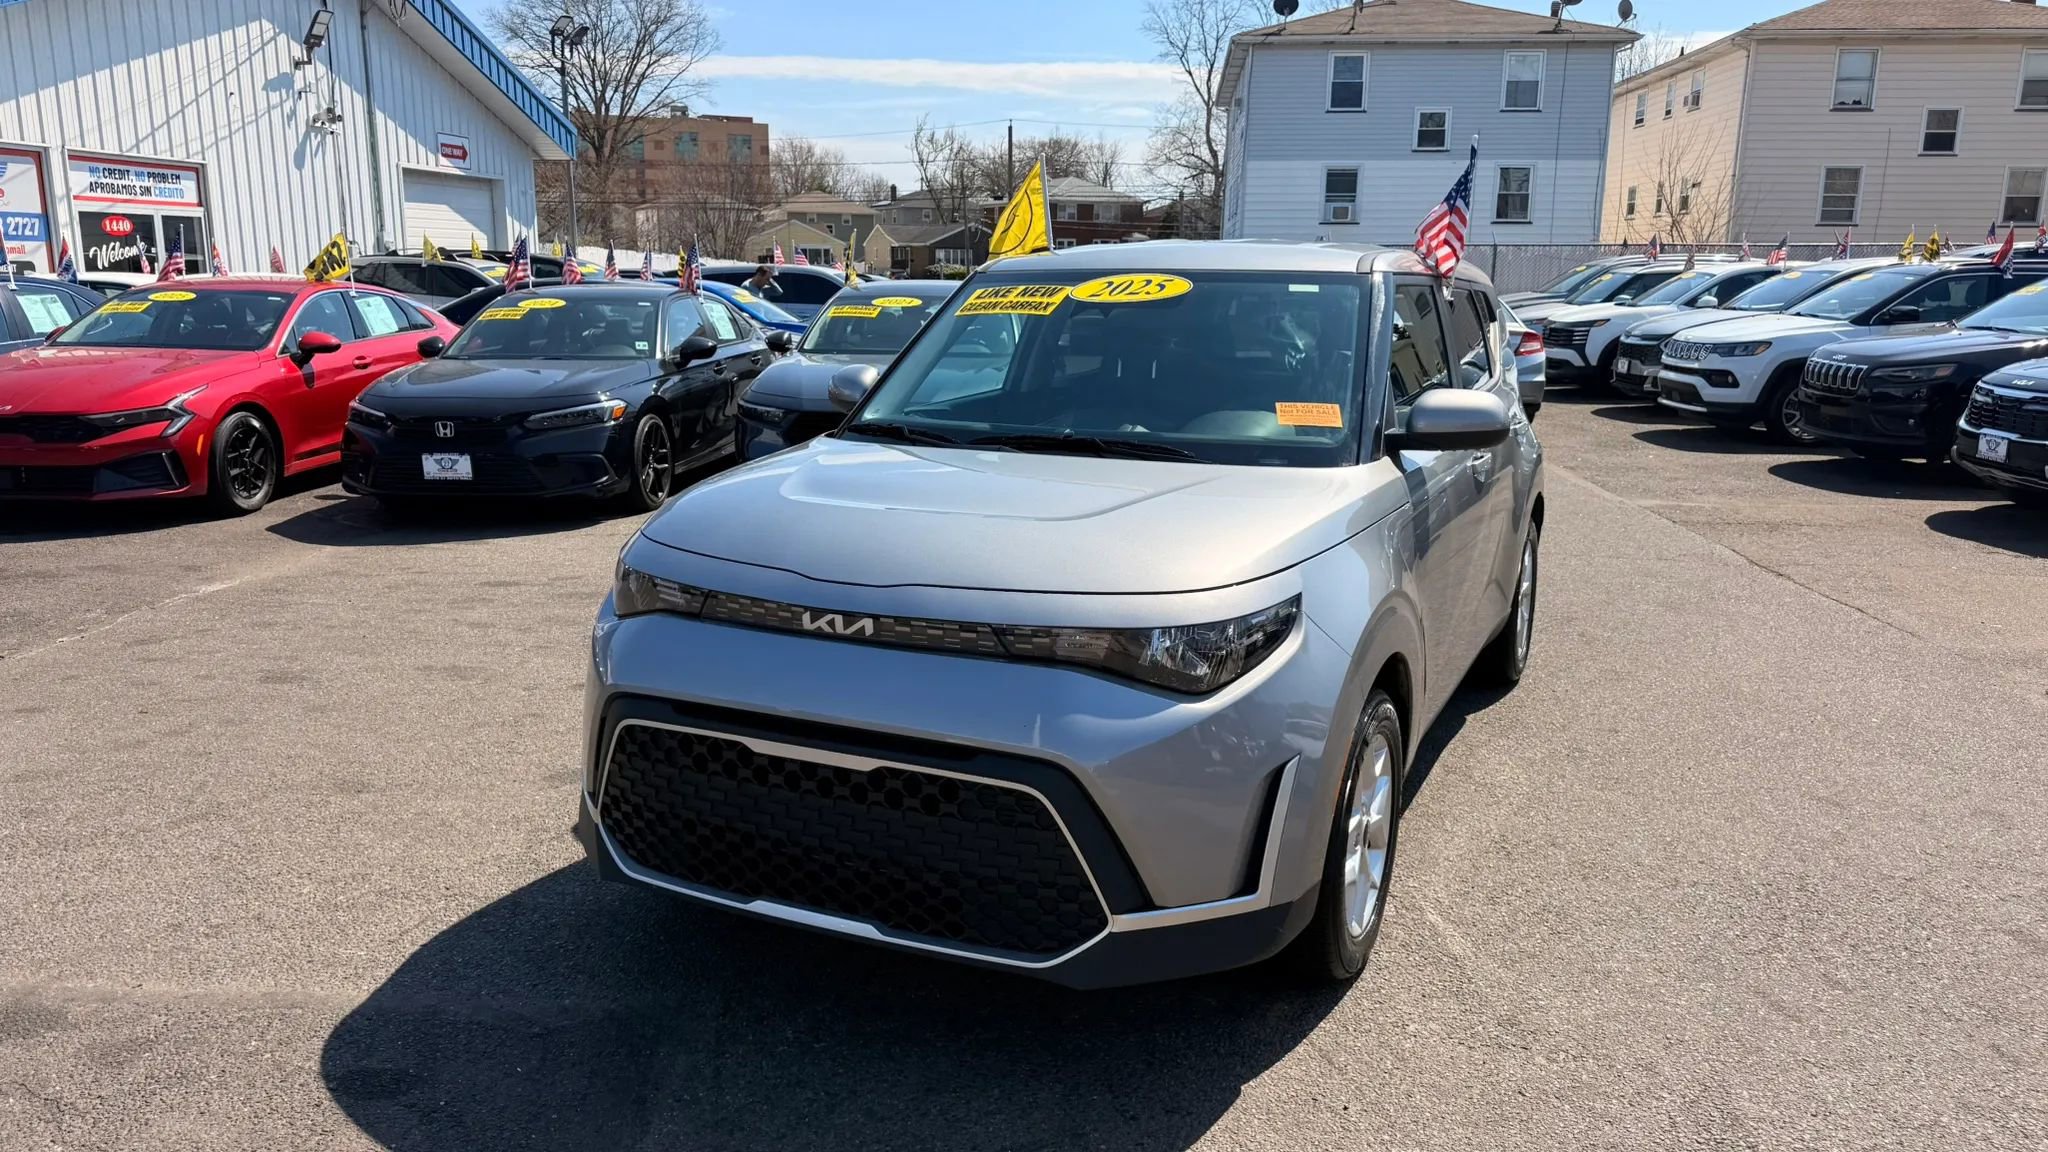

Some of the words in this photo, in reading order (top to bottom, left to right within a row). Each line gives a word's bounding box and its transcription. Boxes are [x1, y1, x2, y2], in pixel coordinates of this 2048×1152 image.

[441, 146, 452, 155] ONE
[452, 148, 463, 157] WAY
[89, 165, 101, 179] NO
[102, 167, 133, 183] CREDIT,
[134, 170, 146, 183] NO
[147, 171, 181, 185] PROBLEM
[89, 181, 138, 196] APROBAMOS
[139, 185, 152, 197] SIN
[6, 216, 40, 236] 2727
[104, 219, 131, 232] 1440
[89, 241, 147, 270] Welcome
[974, 287, 1017, 300] LIKE
[1014, 286, 1064, 298] NEW
[1087, 279, 1175, 298] 2025
[959, 300, 998, 313] CLEAN
[999, 300, 1055, 312] CARFAX
[802, 610, 874, 636] KIA
